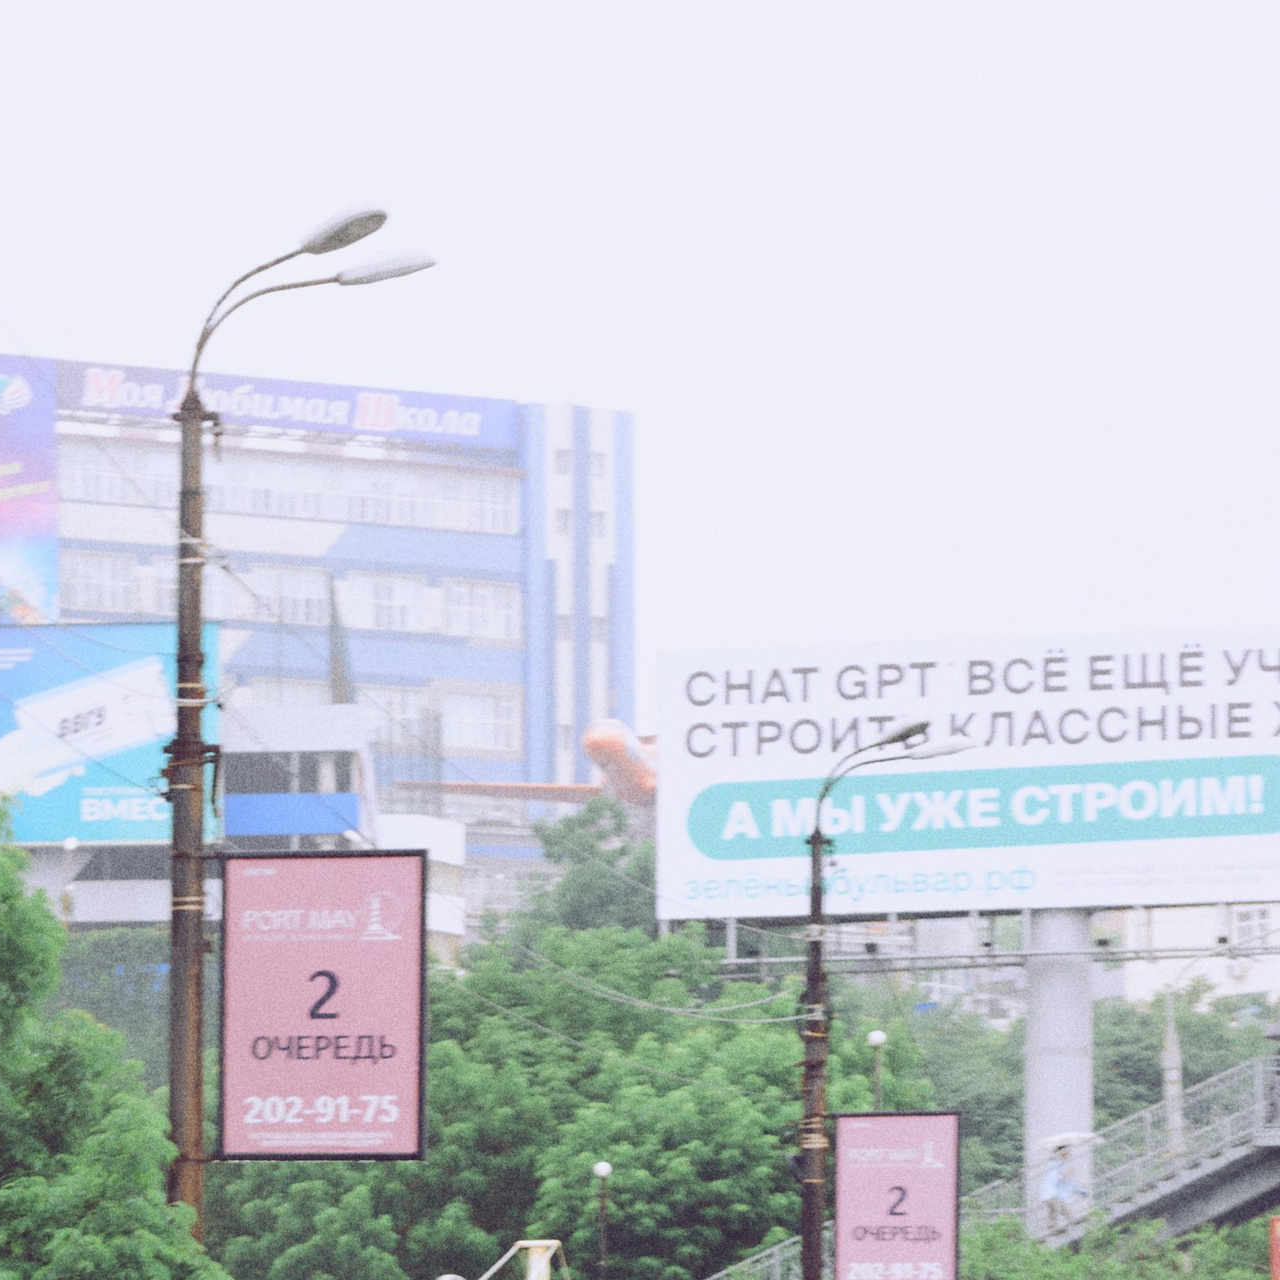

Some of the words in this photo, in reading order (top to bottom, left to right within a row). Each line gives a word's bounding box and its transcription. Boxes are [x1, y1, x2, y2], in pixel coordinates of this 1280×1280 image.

[82, 368, 165, 410] Моя
[354, 391, 482, 437] Школа
[686, 667, 819, 706] CHAT
[836, 661, 937, 701] GPT
[969, 649, 1068, 695] ВСЁ
[1089, 644, 1204, 695] ЕЩЁ
[949, 701, 1253, 748] КЛАССНЫЕ
[721, 800, 761, 840] А
[773, 795, 866, 837] МЫ
[875, 787, 1001, 832] УЖЕ
[1010, 774, 1265, 826] СТРОИМ!
[309, 970, 340, 1020] 2
[252, 1034, 398, 1065] ОЧЕРЕДЬ
[243, 1094, 400, 1125] 202-91-75
[888, 1186, 908, 1216] 2
